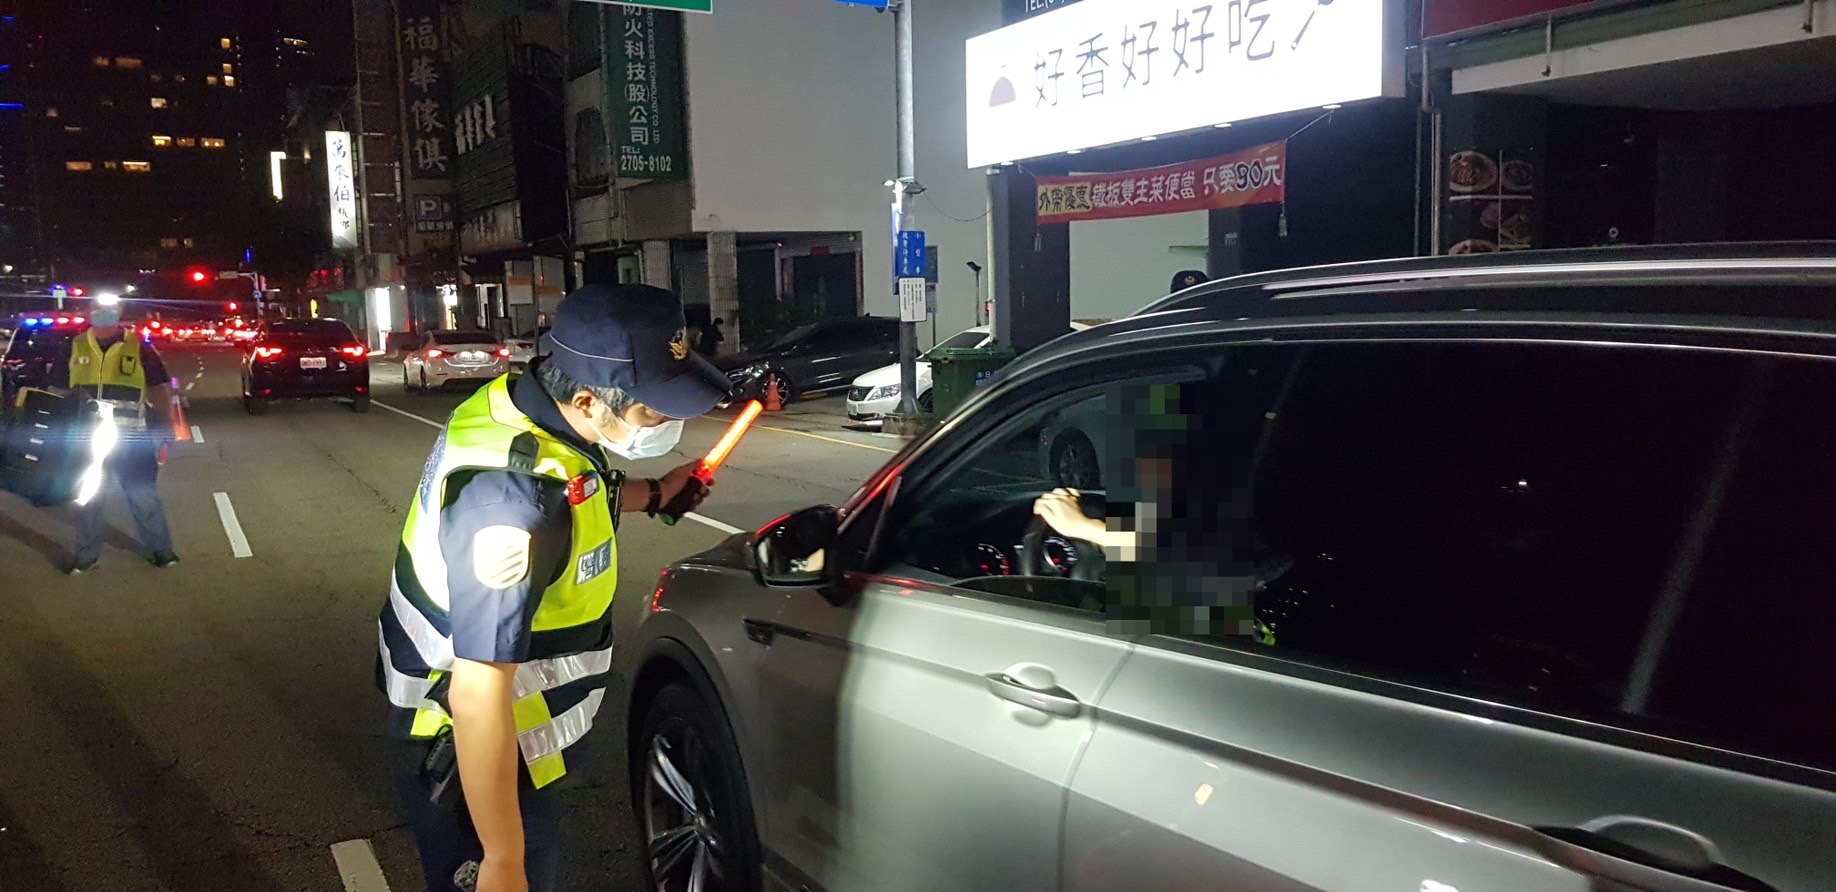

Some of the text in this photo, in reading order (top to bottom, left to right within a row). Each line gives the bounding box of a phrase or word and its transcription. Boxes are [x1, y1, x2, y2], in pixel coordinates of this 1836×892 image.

[647, 29, 655, 59] EXCESS
[1034, 0, 1275, 108] 好香好好吃
[404, 16, 448, 172] 福華傢俱
[649, 61, 658, 114] TECHNOLOGY
[621, 145, 640, 154] TEL:
[621, 155, 672, 172] 2705-8102
[1039, 184, 1092, 212] 外帶優惠
[1203, 155, 1282, 195] 只要90元
